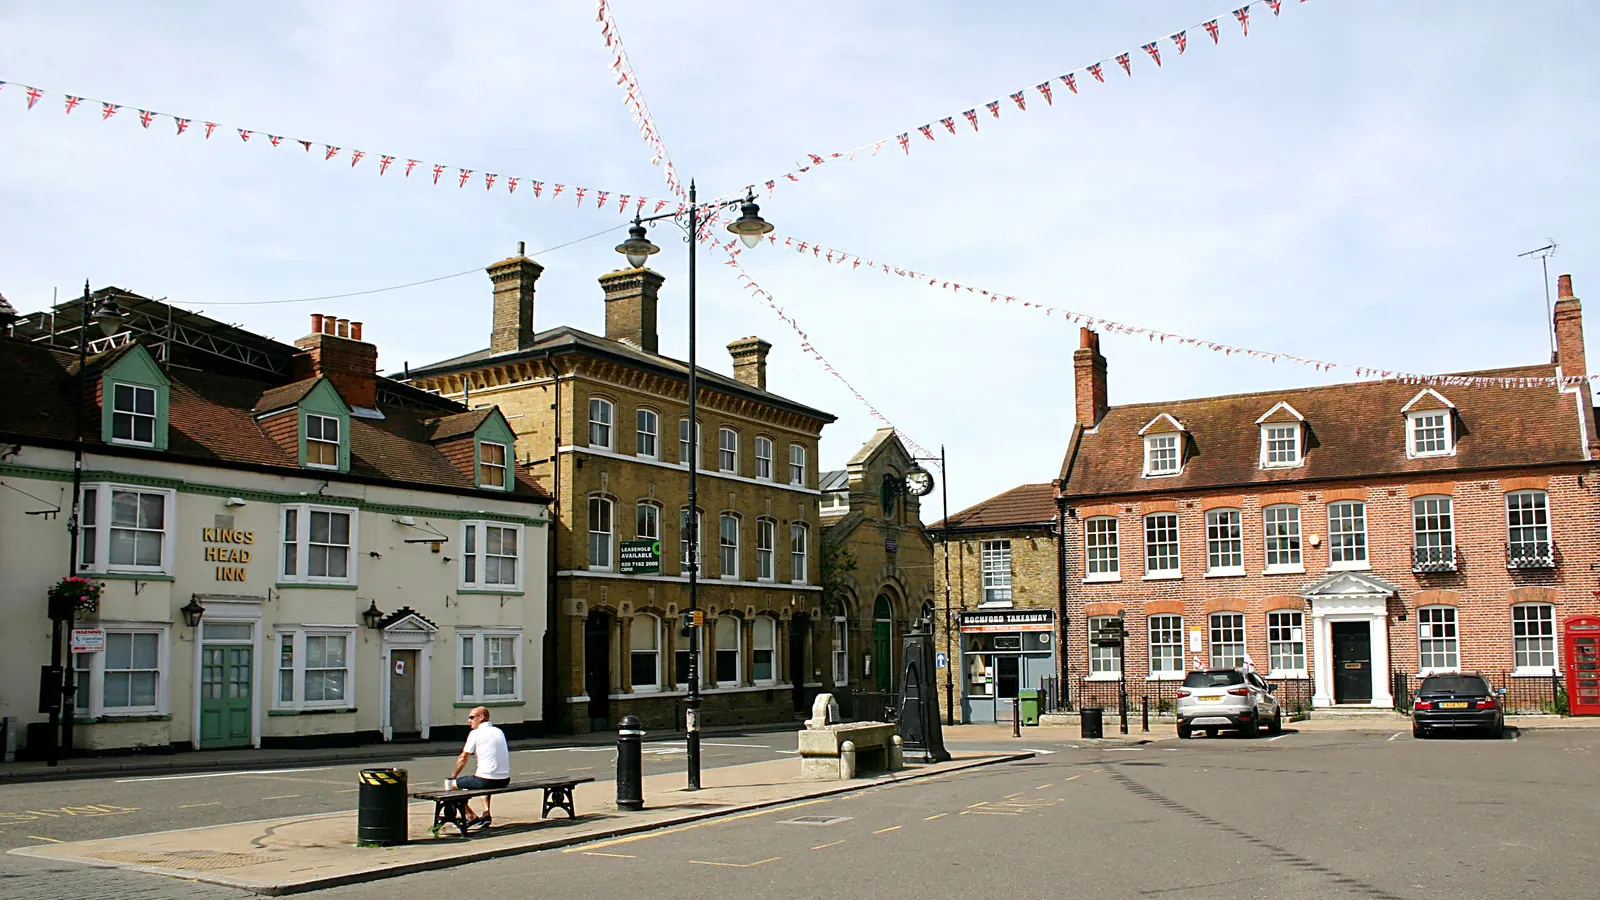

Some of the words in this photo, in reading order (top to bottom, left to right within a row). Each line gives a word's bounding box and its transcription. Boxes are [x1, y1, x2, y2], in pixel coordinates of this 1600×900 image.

[203, 527, 254, 545] KINGS
[204, 547, 252, 563] HEAD
[216, 566, 246, 582] INN
[964, 615, 1004, 624] ROCHFORD
[1006, 614, 1047, 622] TAKEAWAY
